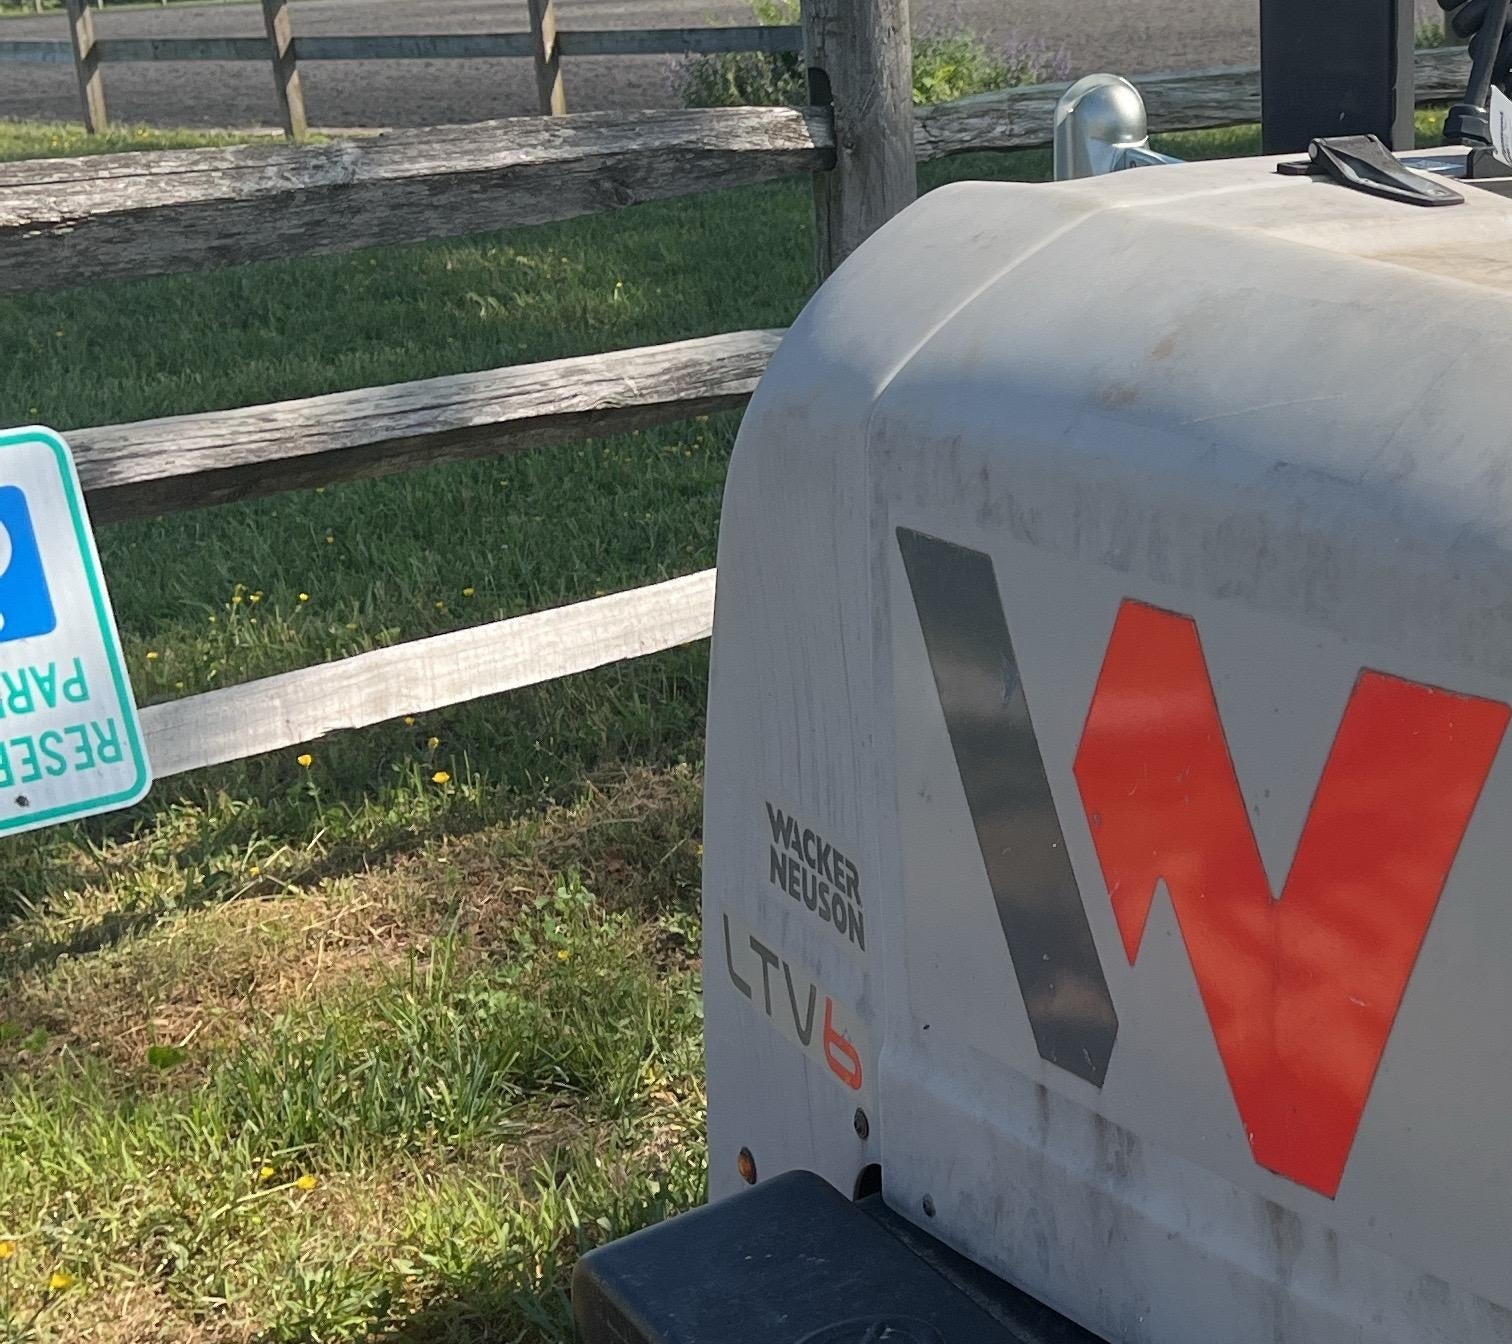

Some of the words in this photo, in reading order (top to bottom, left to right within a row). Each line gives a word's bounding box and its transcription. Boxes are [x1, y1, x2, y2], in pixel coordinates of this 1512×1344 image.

[0, 656, 90, 719] PAR
[764, 801, 863, 908] WACKER
[768, 843, 866, 953] NEUSON
